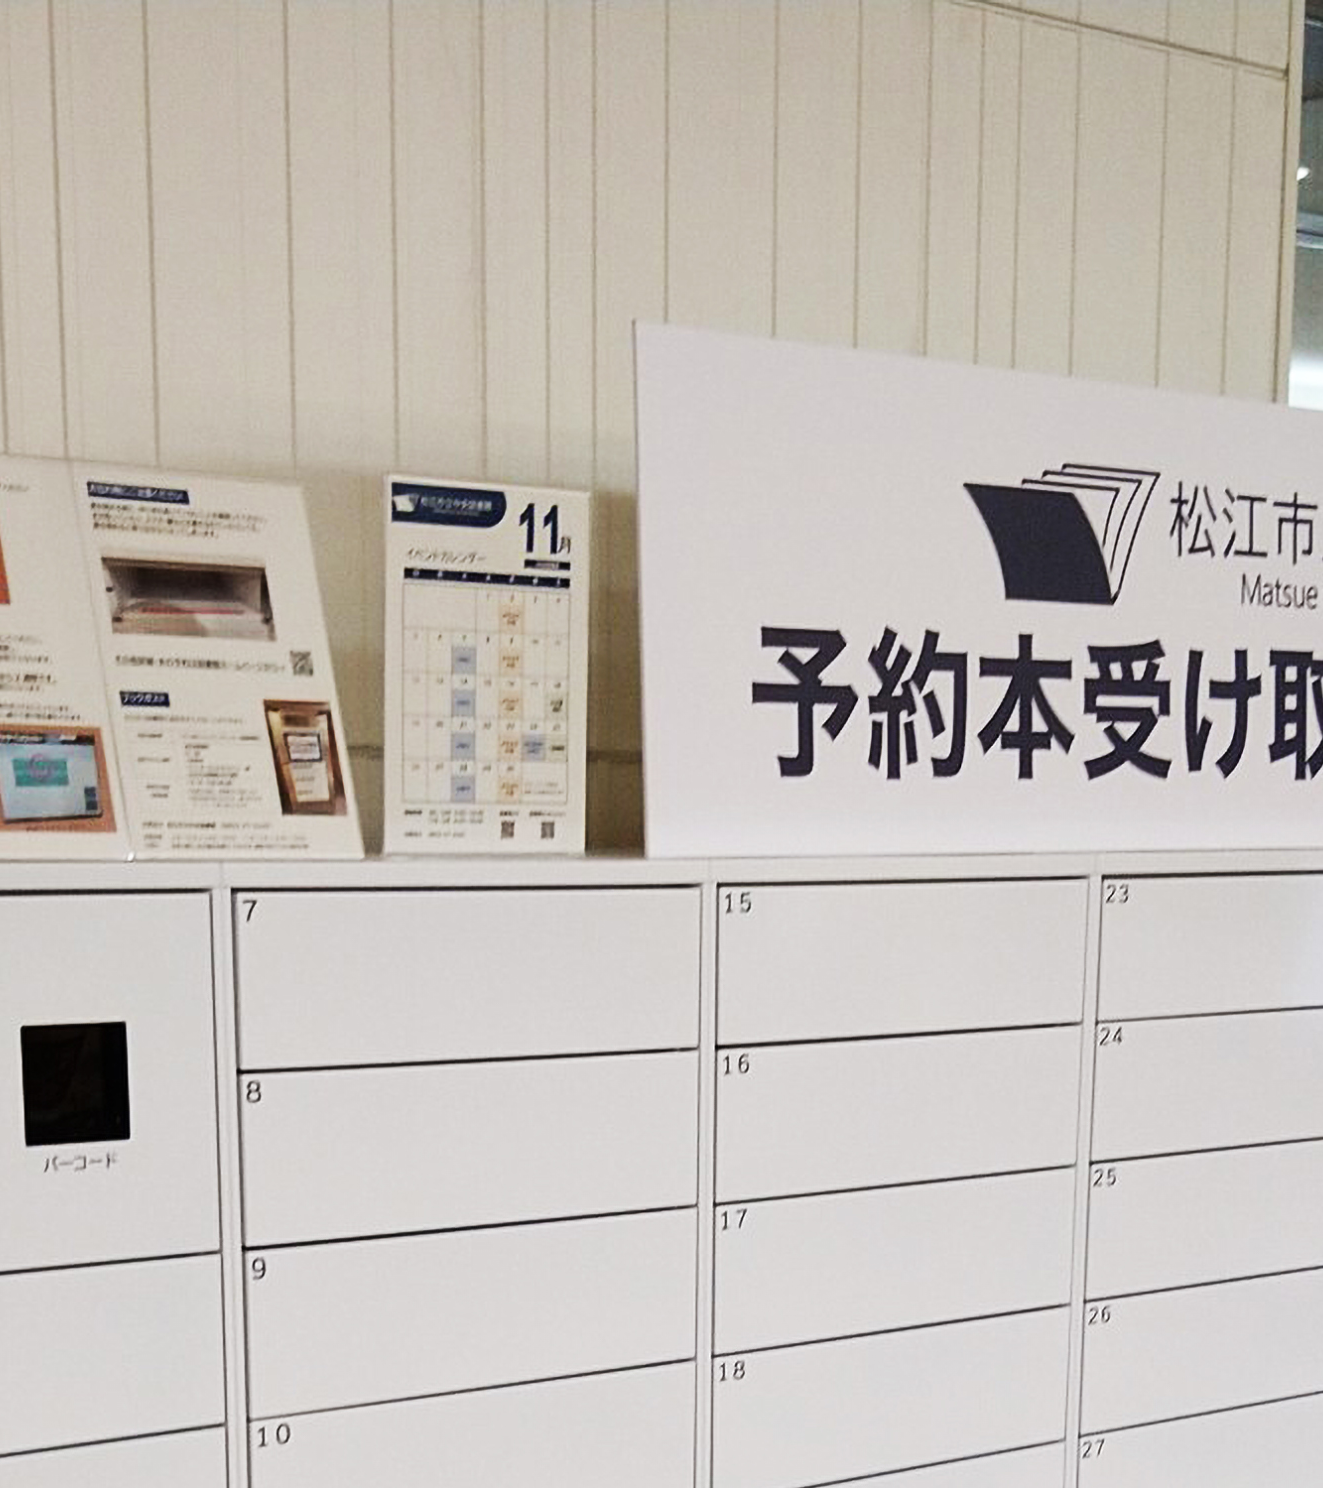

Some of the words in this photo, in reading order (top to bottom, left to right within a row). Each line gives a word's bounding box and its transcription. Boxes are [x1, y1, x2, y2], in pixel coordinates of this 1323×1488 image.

[1240, 573, 1319, 610] Matsue
[725, 892, 752, 913] 15
[1106, 885, 1129, 903] 23
[243, 900, 257, 922] 7
[1099, 1027, 1122, 1046] 24
[724, 1055, 750, 1074] 16
[247, 1081, 262, 1103] 8
[43, 1154, 118, 1174] バーコード
[1093, 1168, 1116, 1187] 25
[722, 1209, 748, 1230] 17
[251, 1258, 266, 1280] 9
[1088, 1307, 1110, 1324] 26
[720, 1361, 745, 1381] 18
[258, 1423, 291, 1447] 10
[1083, 1439, 1105, 1458] 27
